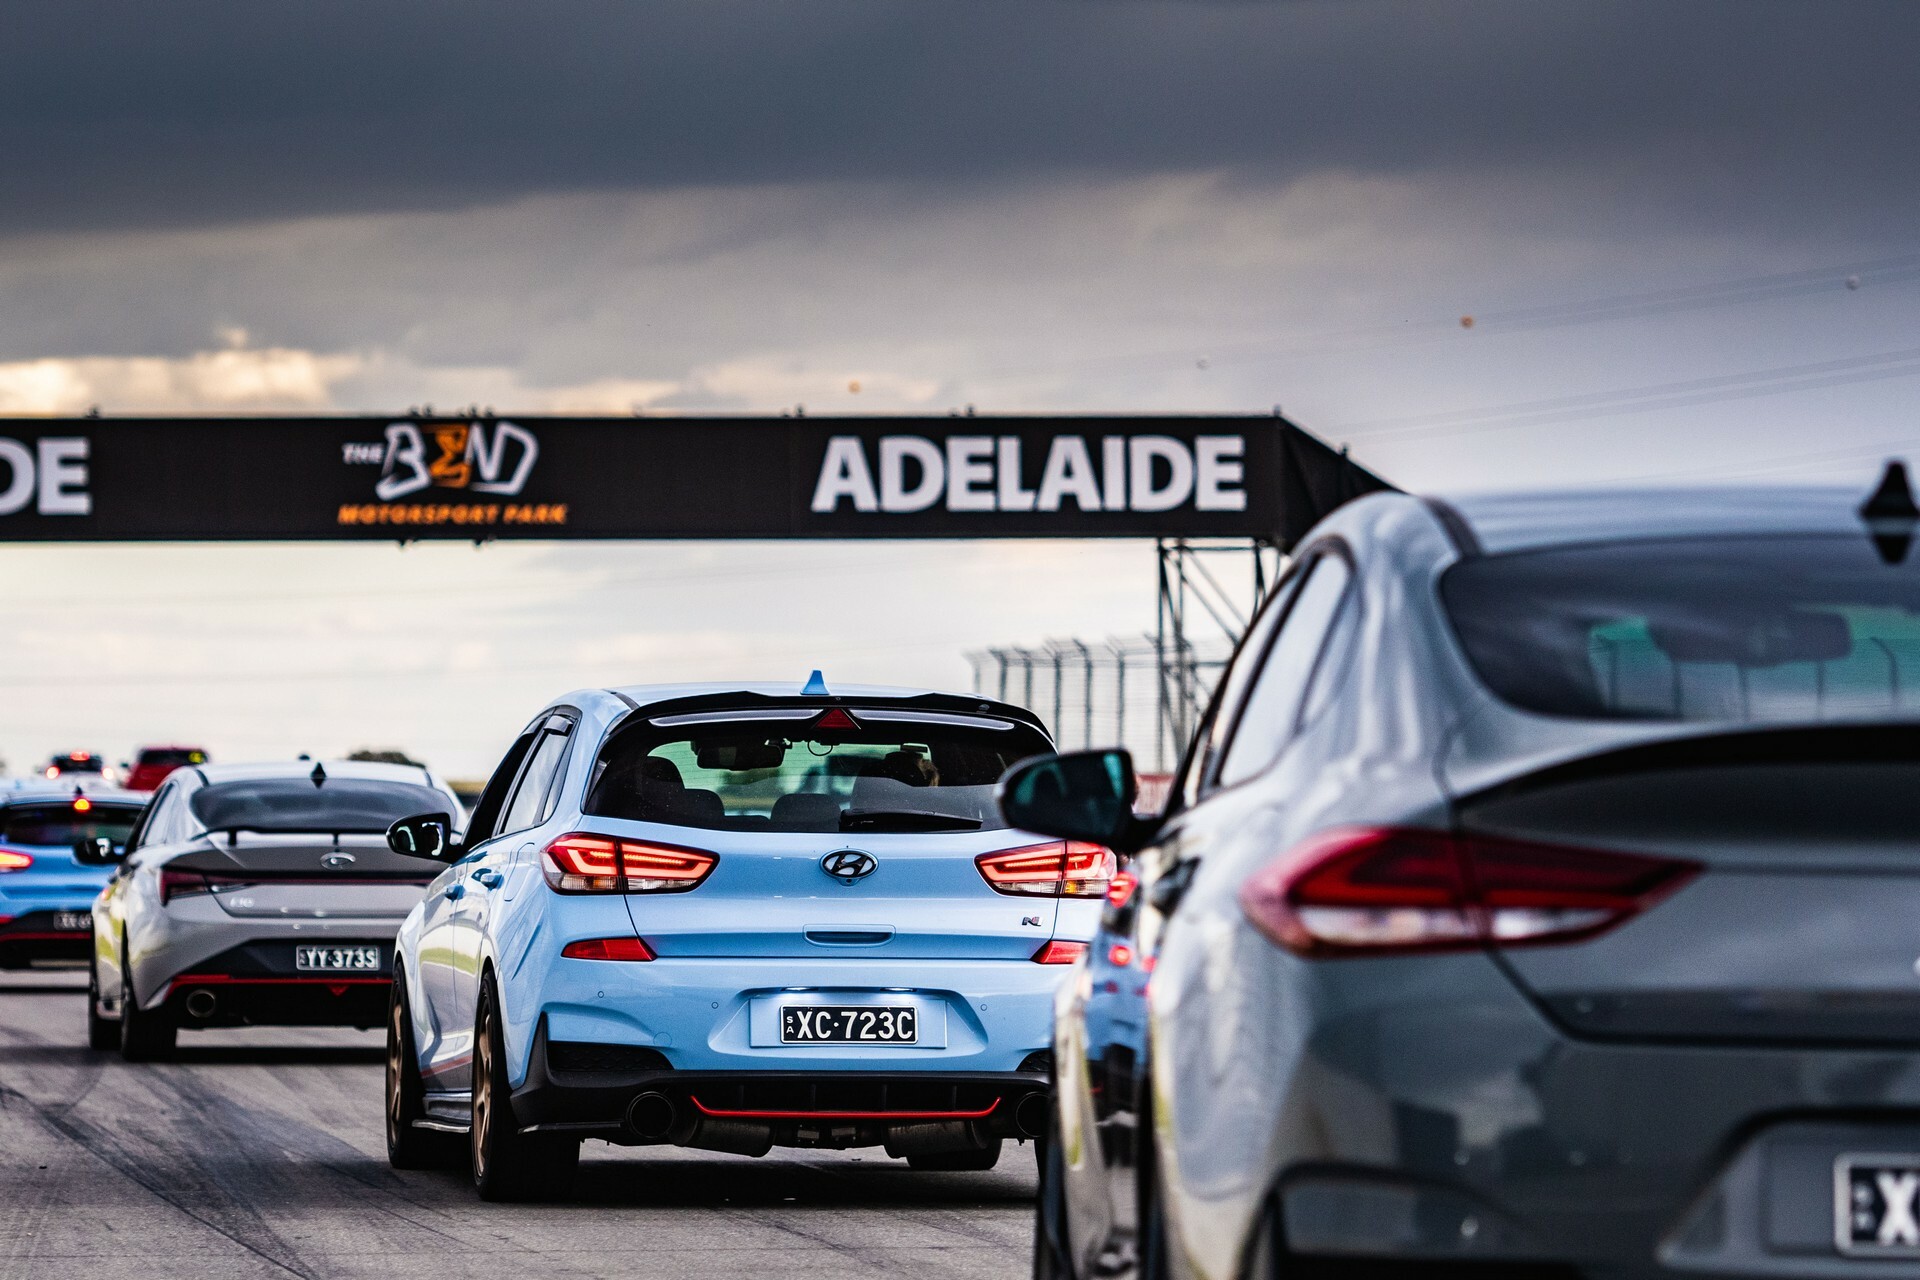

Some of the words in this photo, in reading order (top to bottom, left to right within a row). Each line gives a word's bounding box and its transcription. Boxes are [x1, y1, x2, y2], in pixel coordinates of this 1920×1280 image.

[342, 443, 384, 464] THE
[811, 436, 1247, 512] ADELAIDE
[337, 504, 499, 525] MOTORSPORT
[502, 504, 567, 525] PARK
